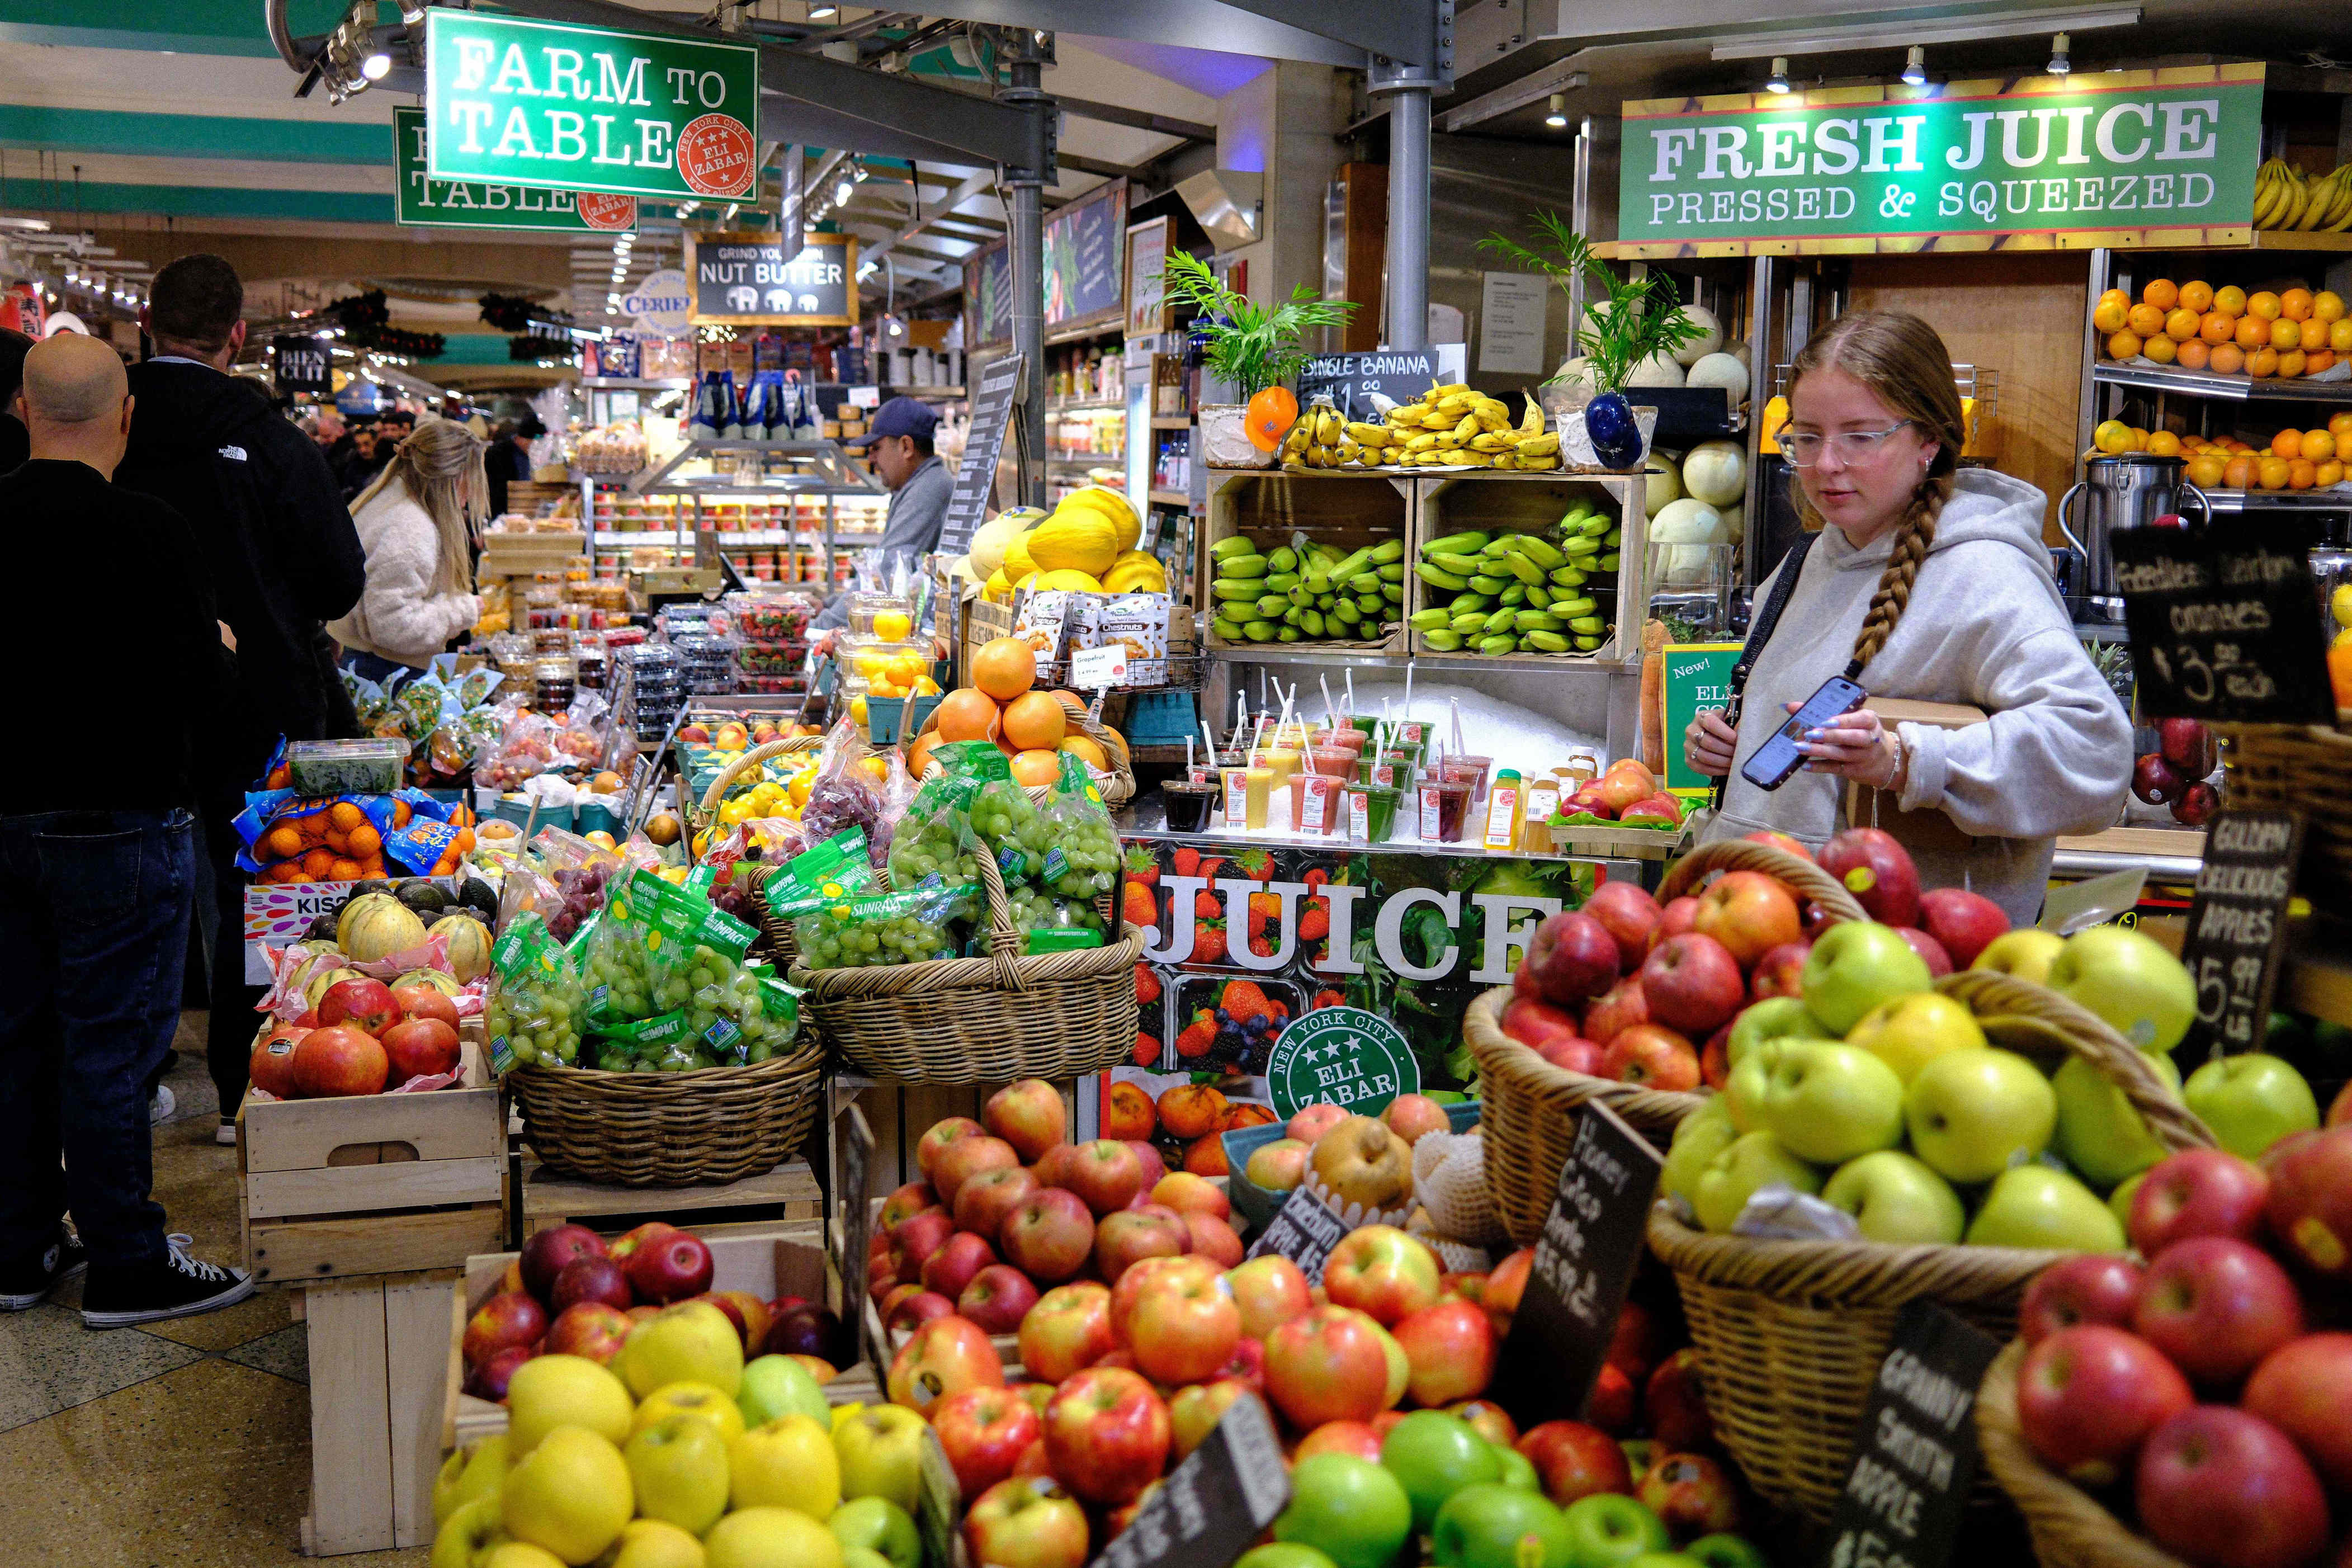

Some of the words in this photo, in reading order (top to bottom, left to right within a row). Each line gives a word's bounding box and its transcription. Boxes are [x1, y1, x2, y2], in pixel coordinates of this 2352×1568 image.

[452, 36, 651, 106] FARM
[667, 67, 726, 109] TO
[450, 100, 672, 169] TABLE
[680, 129, 693, 153] NEW
[693, 116, 720, 130] YORK
[723, 118, 747, 136] CITY
[1649, 115, 1926, 182] FRESH
[1945, 99, 2219, 171] JUICE
[702, 142, 730, 160] ELI
[695, 152, 747, 176] ZABAR
[1647, 186, 1857, 225] PRESSED
[1879, 184, 1916, 218] &
[1939, 173, 2215, 223] SQUEEZED
[718, 247, 757, 260] GRIND
[700, 263, 748, 284] NUT
[755, 263, 842, 285] BUTTER
[281, 349, 326, 367] BIEN
[1301, 356, 1354, 377] SINGLE
[1361, 355, 1430, 376] BANANA
[280, 363, 324, 381] CUIT
[1102, 624, 1143, 632] Chestnuts
[1077, 654, 1105, 663] Grapefruit
[1673, 658, 1711, 679] New!
[851, 898, 901, 917] SUNRAYS
[712, 919, 748, 946] IMPACT
[1141, 873, 1562, 985] JUICE
[648, 1019, 679, 1040] IMPACT
[1273, 1035, 1297, 1075] NEW
[1296, 1012, 1347, 1036] YORK
[1354, 1015, 1396, 1044] CITY
[1314, 1057, 1364, 1088] ELI
[1300, 1073, 1395, 1108] ZABAR
